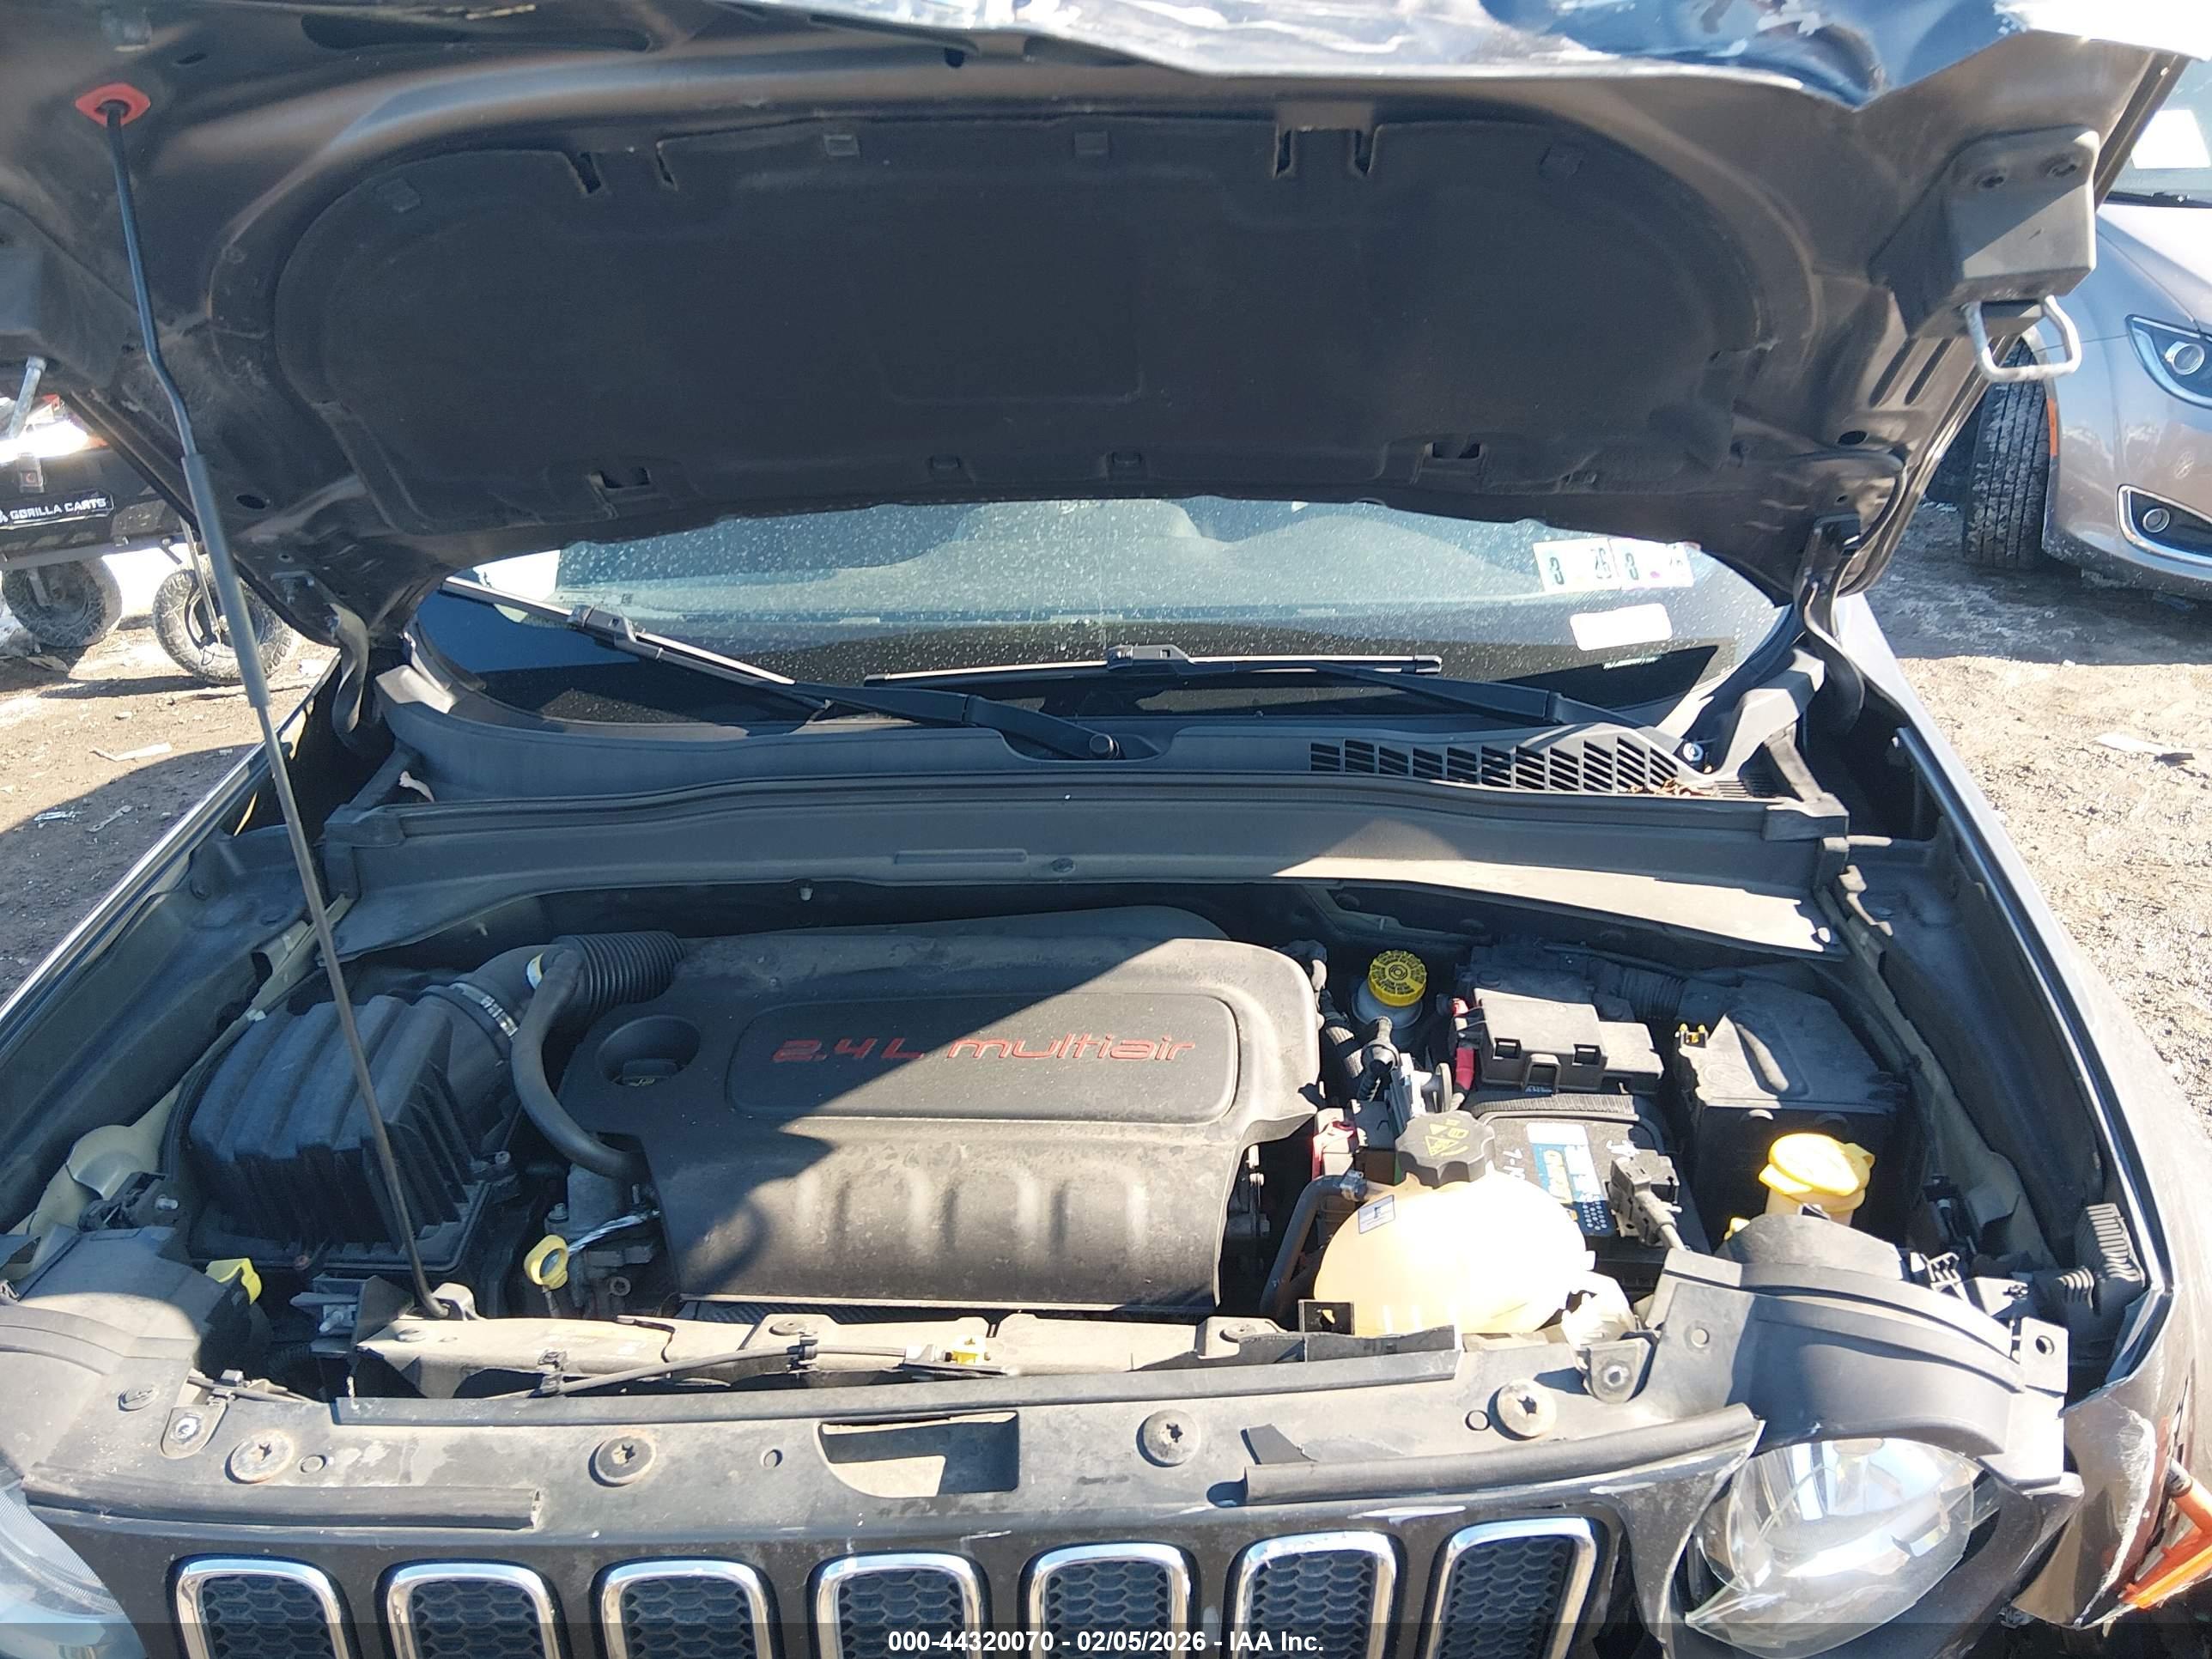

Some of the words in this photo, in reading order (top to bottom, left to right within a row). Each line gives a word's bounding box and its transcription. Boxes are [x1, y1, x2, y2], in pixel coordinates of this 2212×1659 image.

[10, 504, 63, 520] GORILLA
[64, 497, 106, 513] CARTS
[947, 1033, 1195, 1060] multiair
